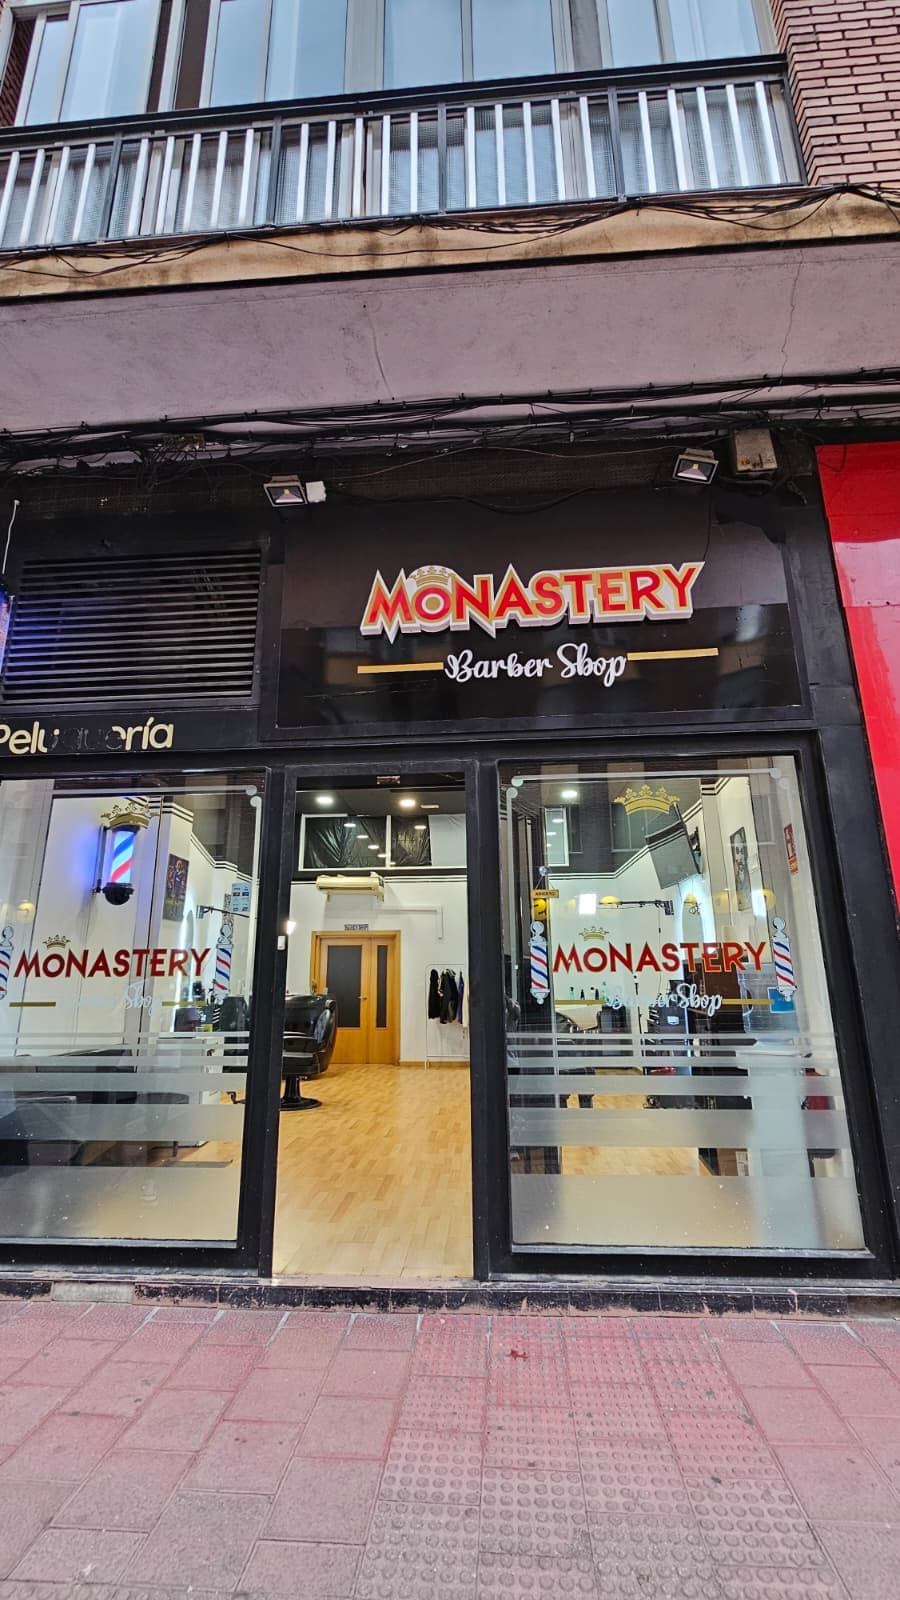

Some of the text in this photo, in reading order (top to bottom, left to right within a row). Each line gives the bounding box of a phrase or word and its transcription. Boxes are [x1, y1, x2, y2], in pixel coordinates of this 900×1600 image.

[360, 561, 705, 644] MONASTERY
[444, 649, 554, 683] Barber
[14, 948, 211, 979] MONASTERY
[553, 941, 767, 974] MONASTERY
